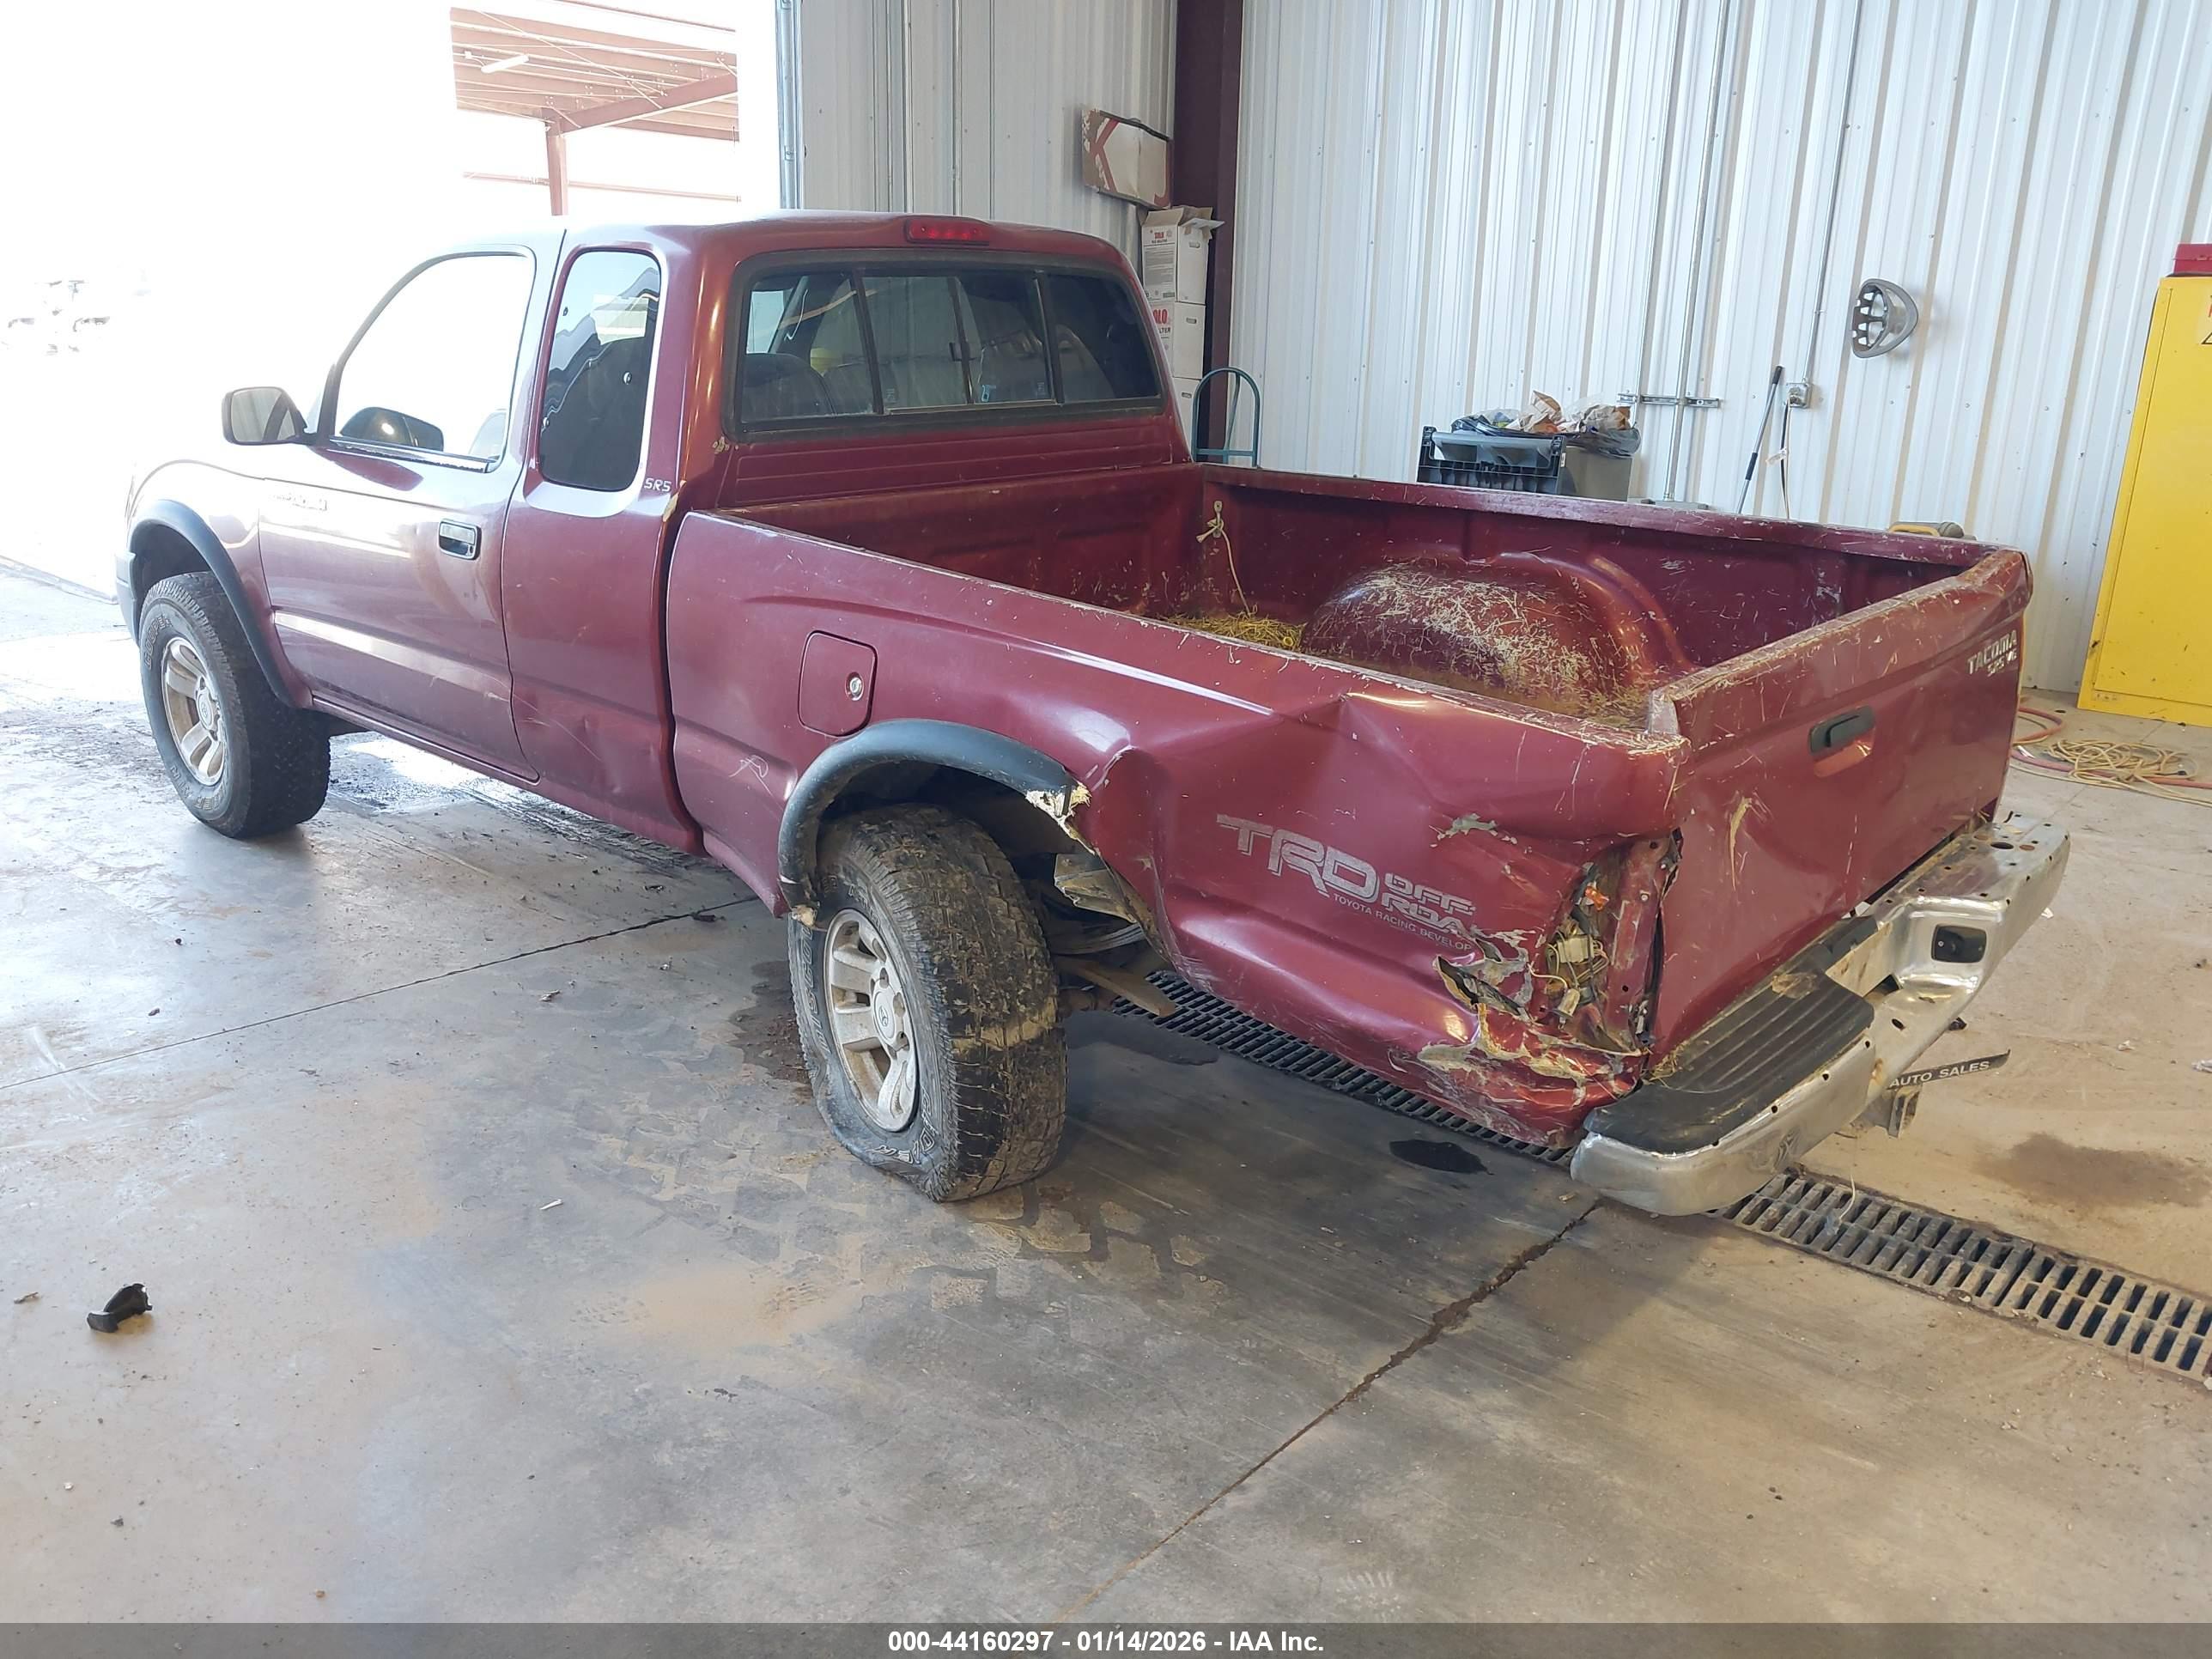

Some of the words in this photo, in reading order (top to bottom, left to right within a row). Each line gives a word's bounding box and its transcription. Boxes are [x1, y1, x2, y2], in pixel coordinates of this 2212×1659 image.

[643, 477, 672, 492] SR5
[1967, 629, 2017, 675] TACOMA
[1216, 814, 1381, 903] TRD
[1384, 872, 1476, 915] OFF
[1333, 893, 1373, 915] TOYOTA
[1376, 910, 1417, 933] RACING
[1419, 928, 1472, 951] DEVELOP
[1889, 1072, 1933, 1088] AUTO
[1939, 1060, 1990, 1079] SALES
